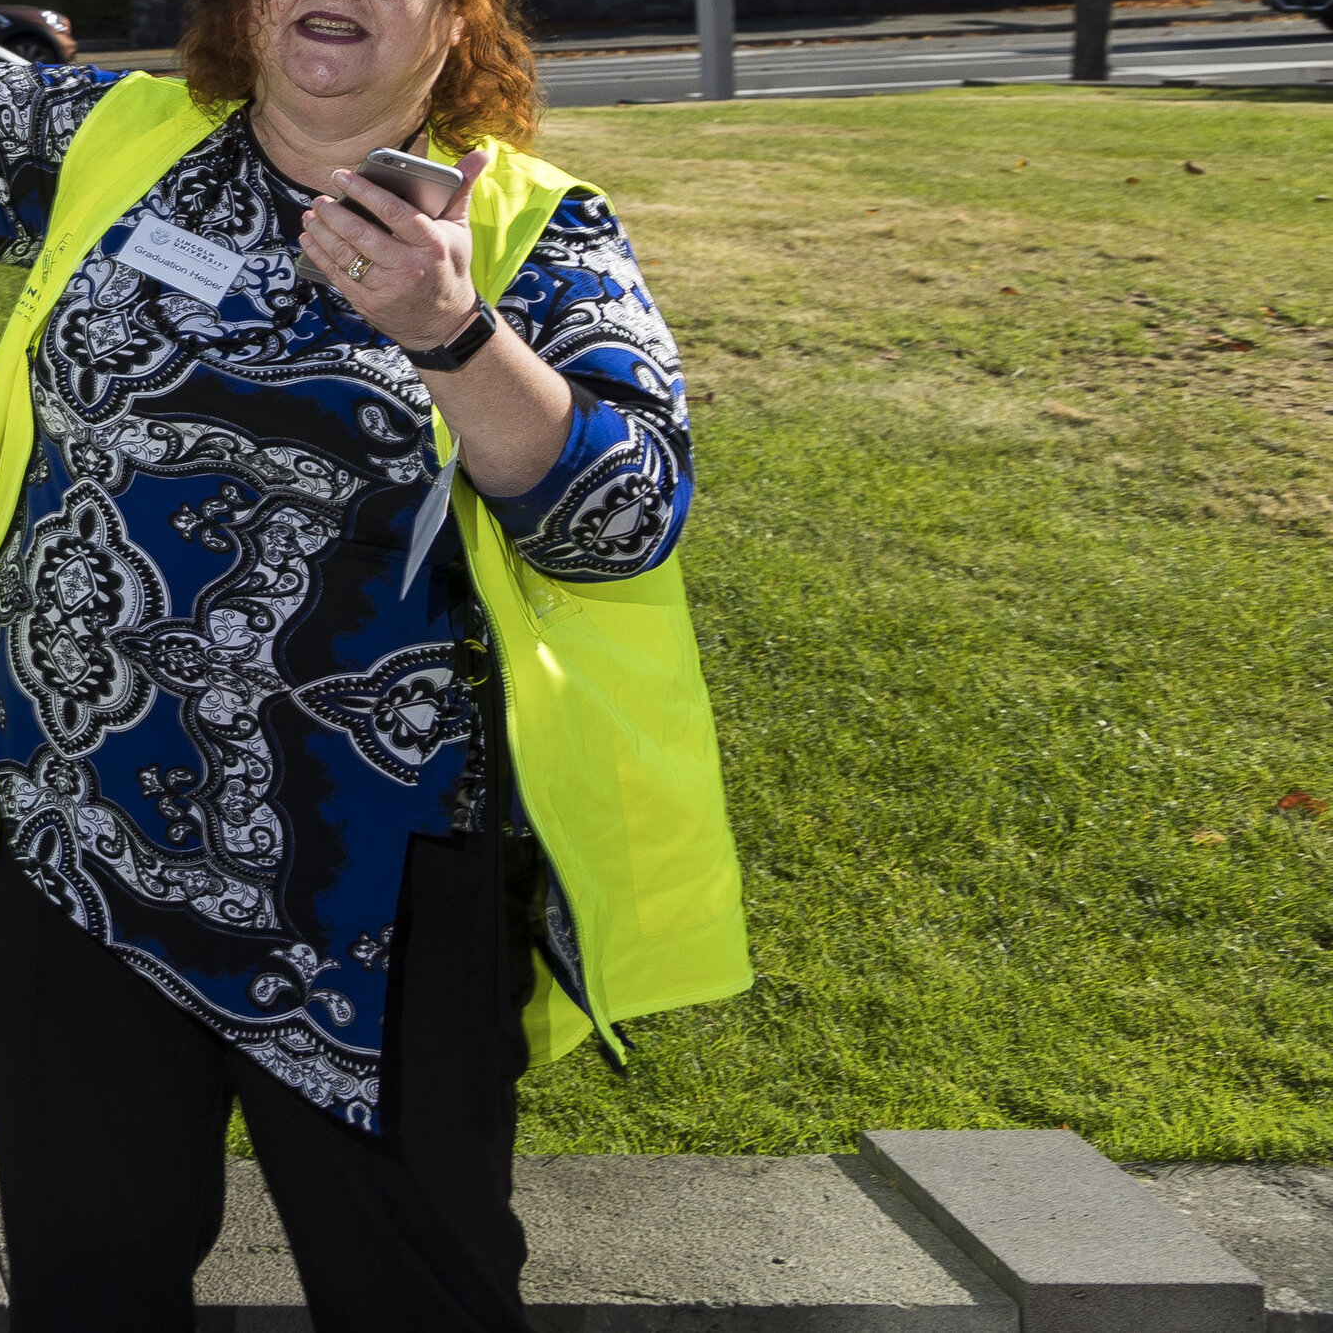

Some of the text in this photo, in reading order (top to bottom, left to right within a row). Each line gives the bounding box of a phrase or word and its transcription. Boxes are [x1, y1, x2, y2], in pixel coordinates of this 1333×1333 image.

[173, 242, 230, 270] UNIVERSITY
[176, 237, 216, 258] LINCOLN
[134, 245, 188, 275] Graduation
[189, 269, 225, 292] Helper
